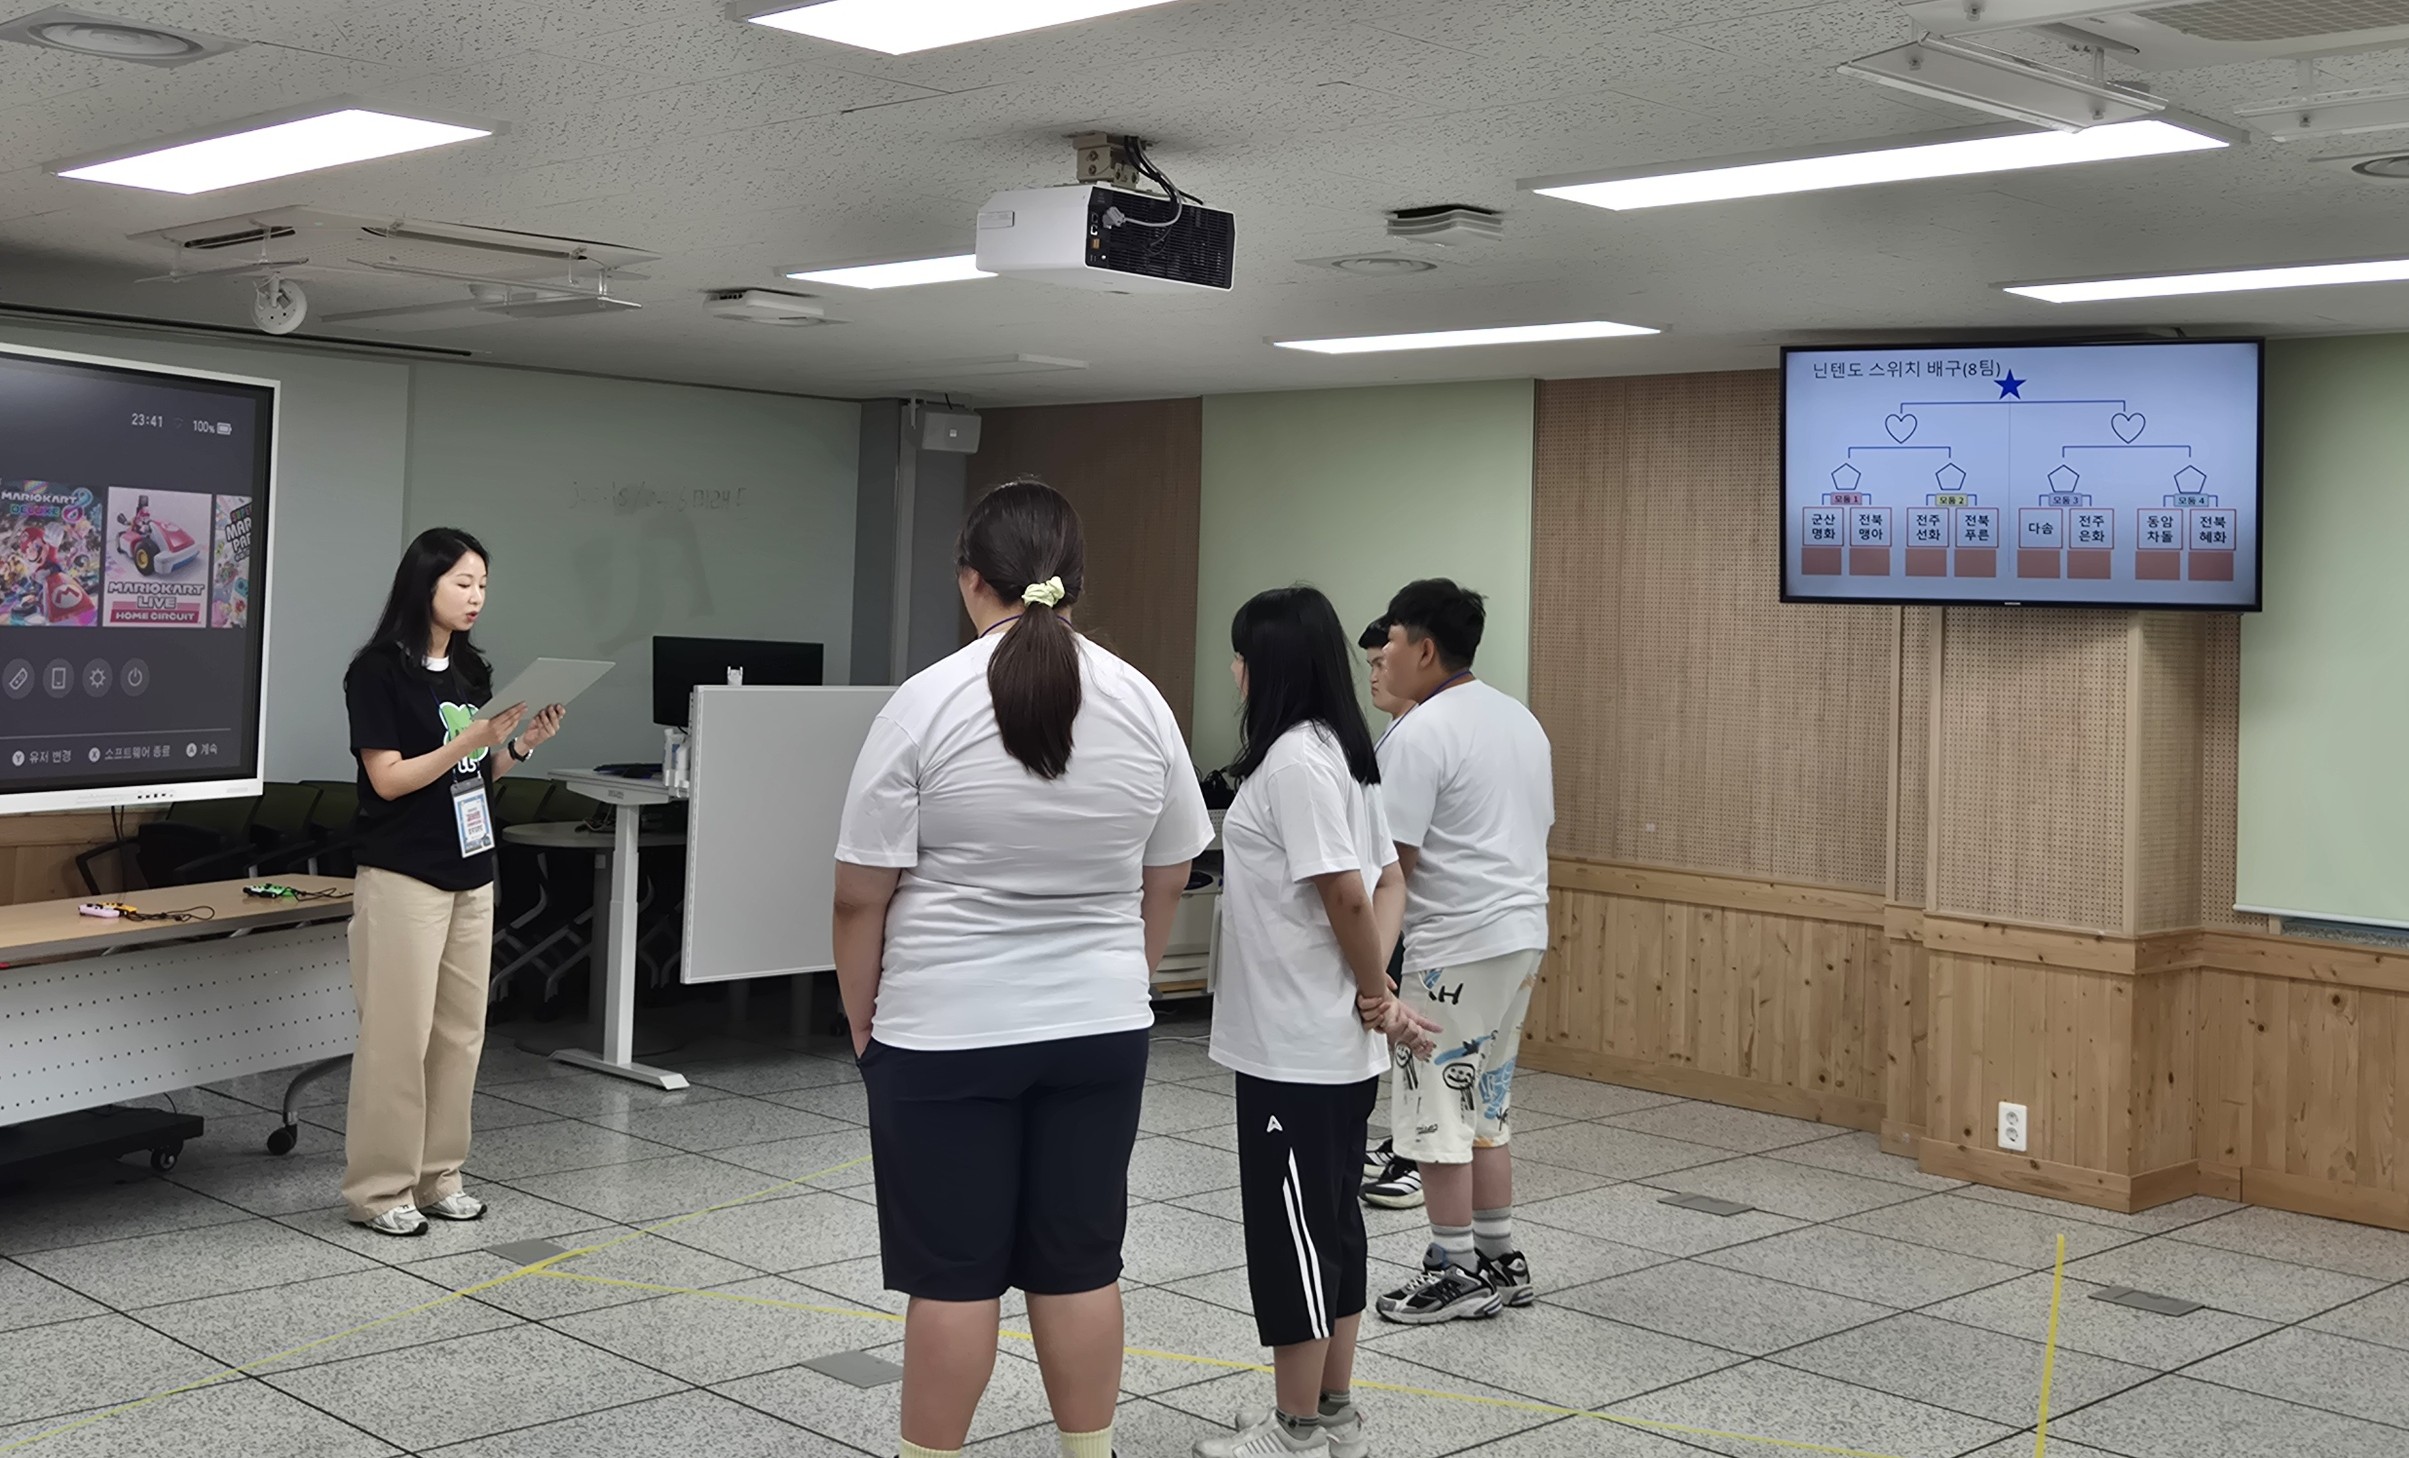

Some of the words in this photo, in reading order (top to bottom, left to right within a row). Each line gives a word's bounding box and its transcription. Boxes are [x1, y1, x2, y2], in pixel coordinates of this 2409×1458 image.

[1813, 362, 1863, 379] 닌텐도
[1869, 360, 1920, 378] 스위치
[1927, 359, 2001, 378] 배구(8팀)
[131, 413, 163, 427] 23:41
[193, 420, 215, 434] 100%
[62, 487, 93, 524] 8
[1959, 496, 1964, 505] 2
[2073, 496, 2079, 505] 3
[10, 503, 60, 518] DELUXE
[1812, 514, 1836, 526] 군산
[1859, 514, 1883, 526] 전북
[1916, 514, 1941, 527] 전주
[1965, 515, 1989, 527] 전북
[2079, 515, 2105, 528] 전주
[2147, 515, 2174, 529] 동암
[2200, 516, 2226, 529] 전북
[1812, 528, 1836, 540] 명화
[1916, 529, 1941, 541] 선화
[1965, 529, 1989, 541] 푸른
[2079, 530, 2105, 543] 은화
[2147, 531, 2173, 543] 차돌
[2199, 531, 2227, 544] 혜화
[137, 596, 177, 609] LIVE
[115, 611, 149, 621] HOME
[150, 611, 195, 622] CIRCUIT
[104, 746, 151, 761] 소프트웨어
[153, 745, 171, 758] 종료
[200, 743, 218, 756] 계속
[29, 751, 49, 765] 유저
[52, 750, 72, 763] 변경
